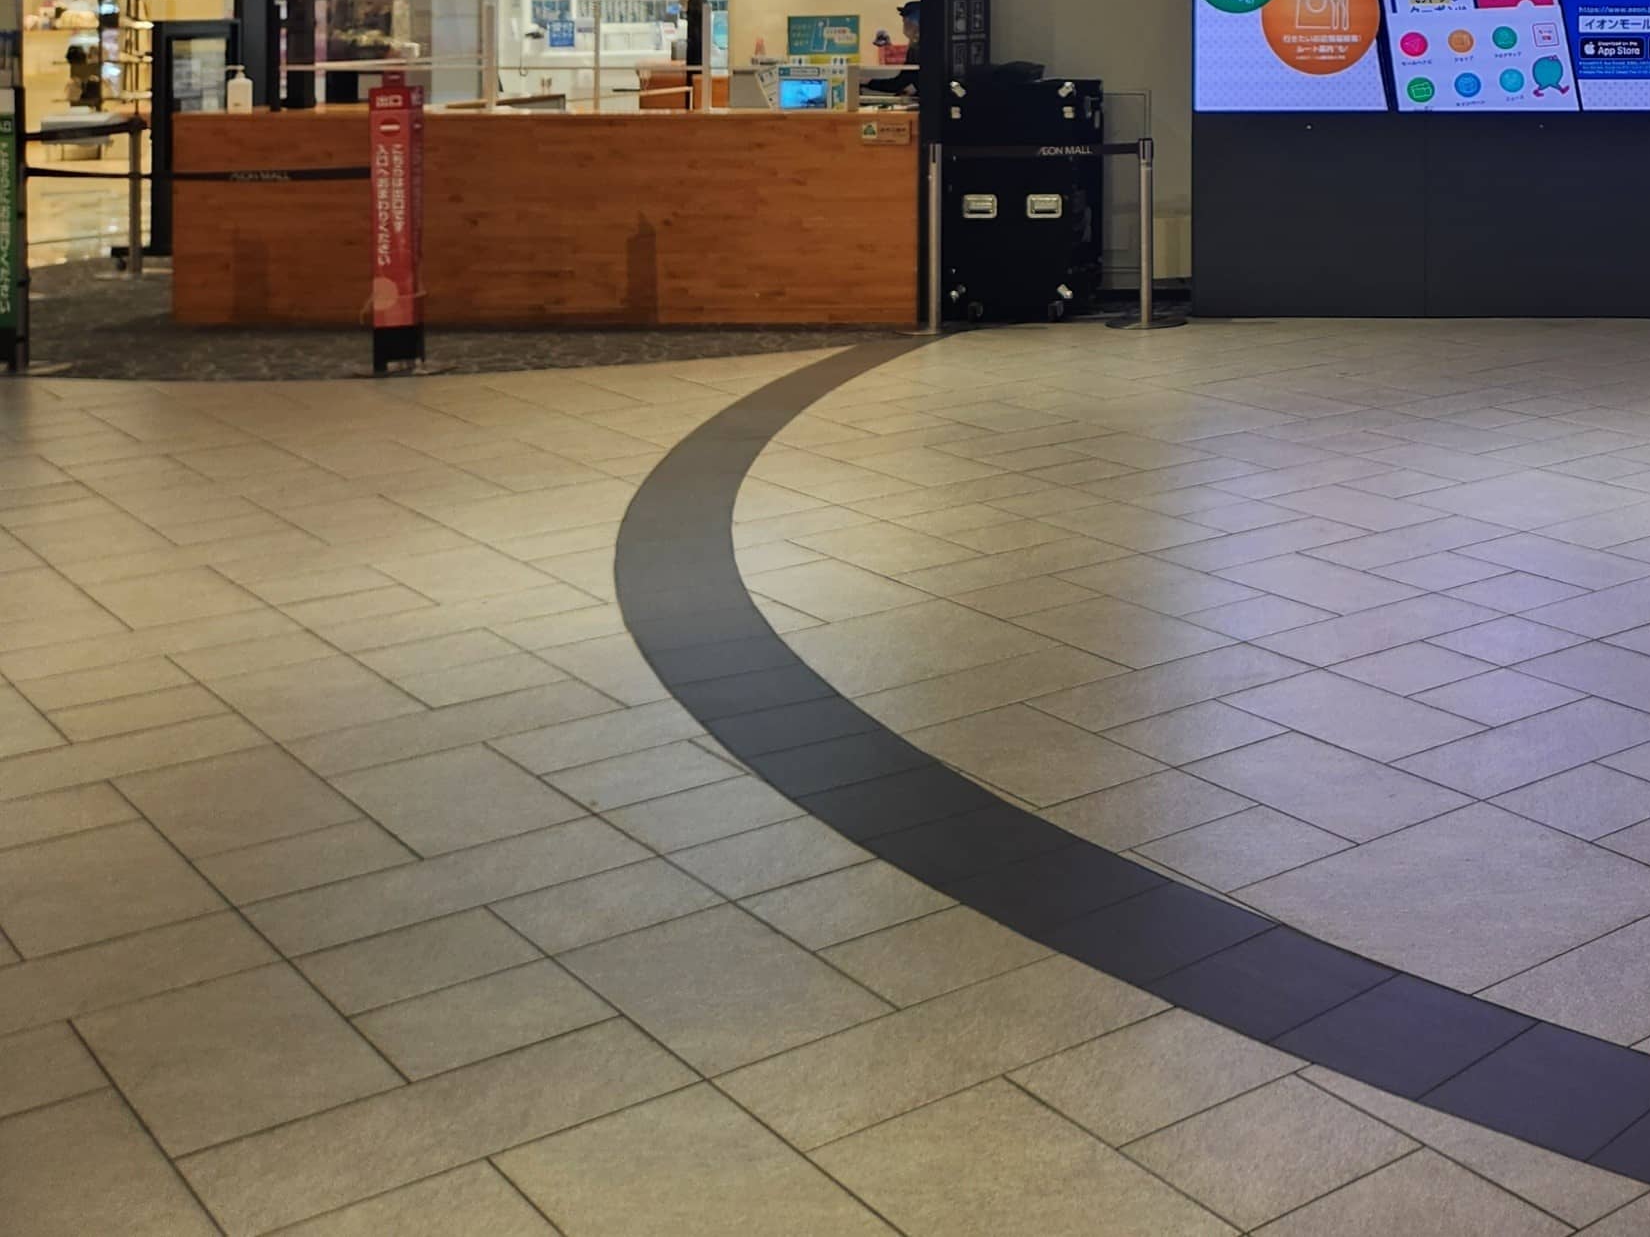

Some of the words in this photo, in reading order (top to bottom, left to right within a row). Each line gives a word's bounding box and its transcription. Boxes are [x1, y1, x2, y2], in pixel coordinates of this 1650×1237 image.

[1598, 46, 1617, 56] App
[1618, 46, 1641, 55] Store
[1065, 145, 1092, 155] MALL
